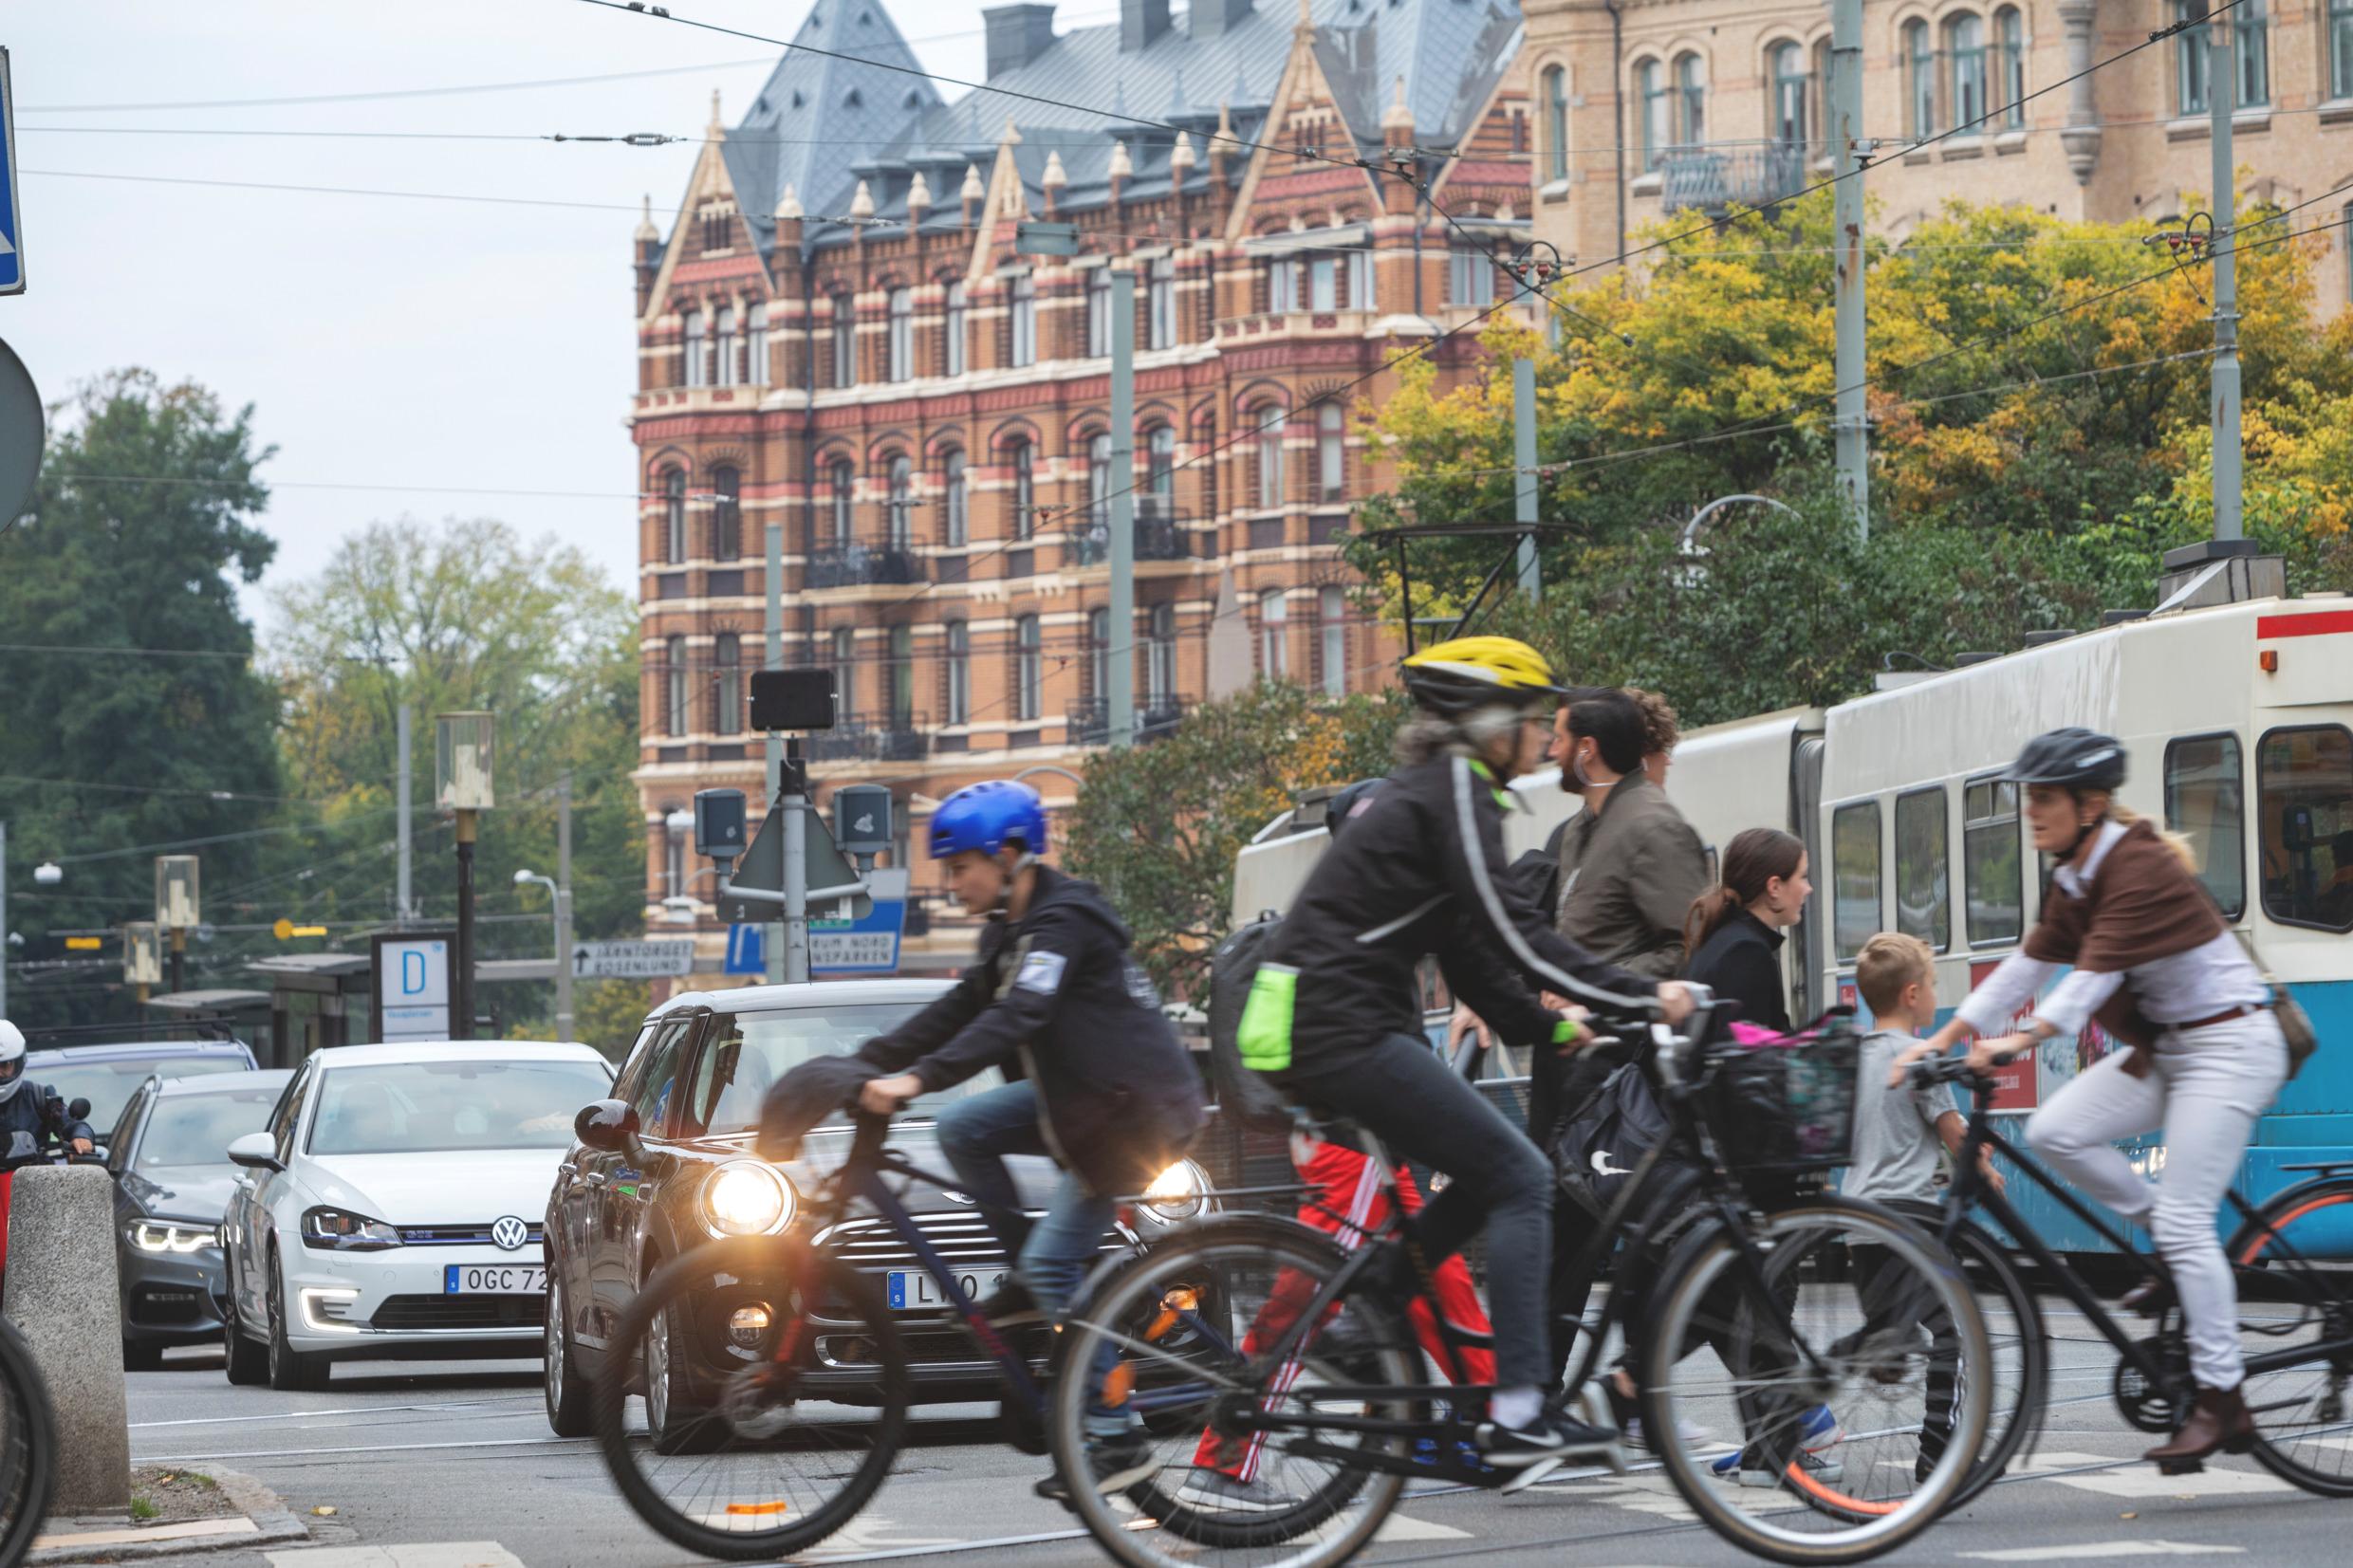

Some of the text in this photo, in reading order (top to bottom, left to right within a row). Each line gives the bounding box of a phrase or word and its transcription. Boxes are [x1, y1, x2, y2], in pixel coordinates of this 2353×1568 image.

[402, 950, 425, 995] D
[468, 1269, 547, 1290] OGC 72
[894, 1294, 900, 1302] S
